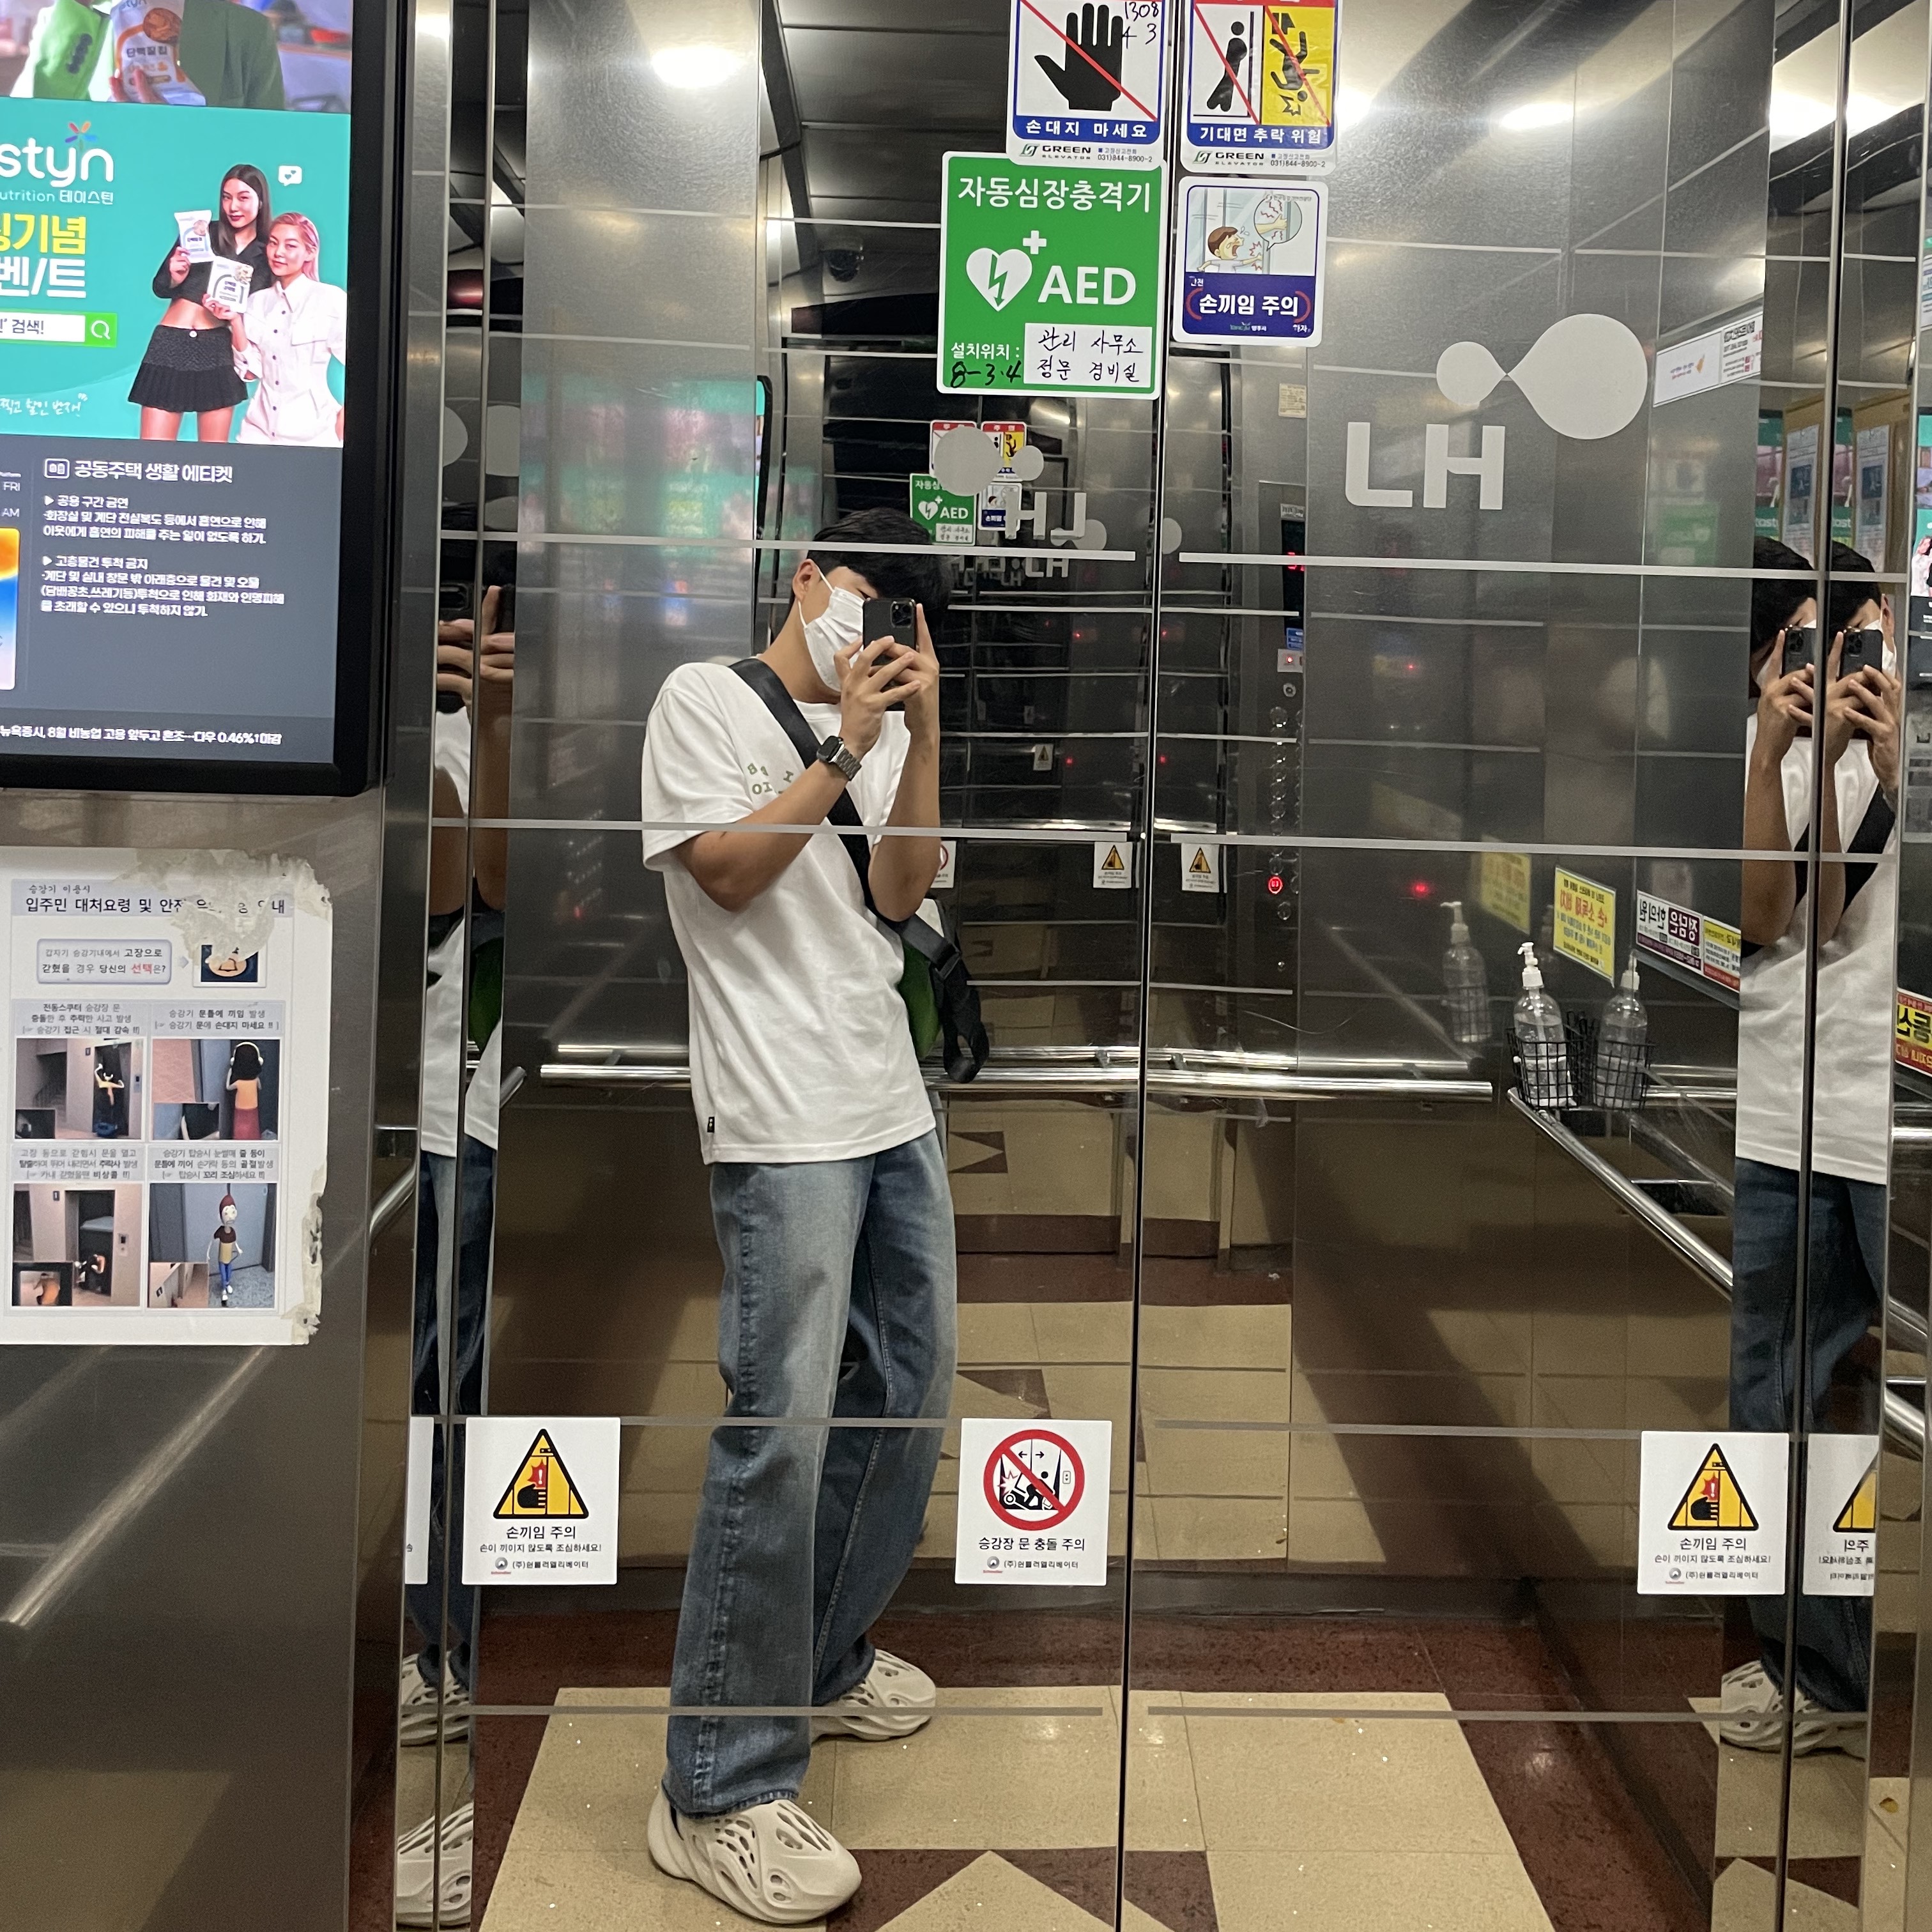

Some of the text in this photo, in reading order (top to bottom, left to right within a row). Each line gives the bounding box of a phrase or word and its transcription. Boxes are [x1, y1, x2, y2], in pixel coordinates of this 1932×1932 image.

[1125, 2, 1160, 22] 1308
[1026, 119, 1147, 137] 손대지 마세요
[1200, 127, 1321, 144] 기대면 추락 위험
[1042, 145, 1091, 154] GREEN
[1098, 154, 1153, 163] 031)844-8900-2
[1270, 160, 1326, 168] 031)844-8900-2
[958, 176, 1151, 213] 자동심장충격기
[1038, 265, 1137, 305] AED
[1199, 293, 1299, 317] 손끼임 주의
[12, 319, 44, 335] 검색!
[1038, 327, 1144, 355] 관리 사무소
[1037, 355, 1140, 383] 정문 경비실
[74, 460, 233, 483] 공동주택 생활 에티켓
[1345, 422, 1506, 510] LH
[3, 482, 20, 491] FRI
[57, 494, 128, 509] 공용 구간 금연
[81, 511, 93, 523] 및
[95, 512, 116, 523] 계단
[940, 507, 969, 519] AED
[43, 525, 87, 538] 이웃에게
[123, 527, 157, 540] 피해를
[158, 528, 181, 540] 주는
[56, 555, 148, 570] 고층물건 투척 금지
[89, 602, 101, 613] 수
[103, 602, 136, 615] 있으니
[68, 728, 102, 740] 비농업
[103, 728, 126, 740] 고용
[128, 729, 160, 741] 앞두고
[29, 884, 91, 894] 승강기 이용시
[26, 898, 151, 913] 입주민 대처요령 및
[124, 949, 162, 958] 고장으로
[76, 964, 95, 973] 경우
[99, 965, 126, 974] 당신의
[131, 963, 166, 974] 선택은?
[169, 1009, 194, 1018] 승강기
[228, 1009, 244, 1018] 끼임
[64, 1026, 80, 1034] 접근
[215, 1022, 238, 1030] 손대지
[241, 1022, 265, 1030] 마세요
[178, 1160, 193, 1169] 끼어
[507, 1526, 576, 1539] 손끼임 주의
[480, 1544, 602, 1553] 손이 끼이지 않도록 조심하세요!
[979, 1537, 1085, 1551] 승강장 문 충돌 주의
[1680, 1537, 1747, 1551] 손끼임 주의
[1654, 1554, 1771, 1564] 손이 끼이지 않도록 조심하세요!
